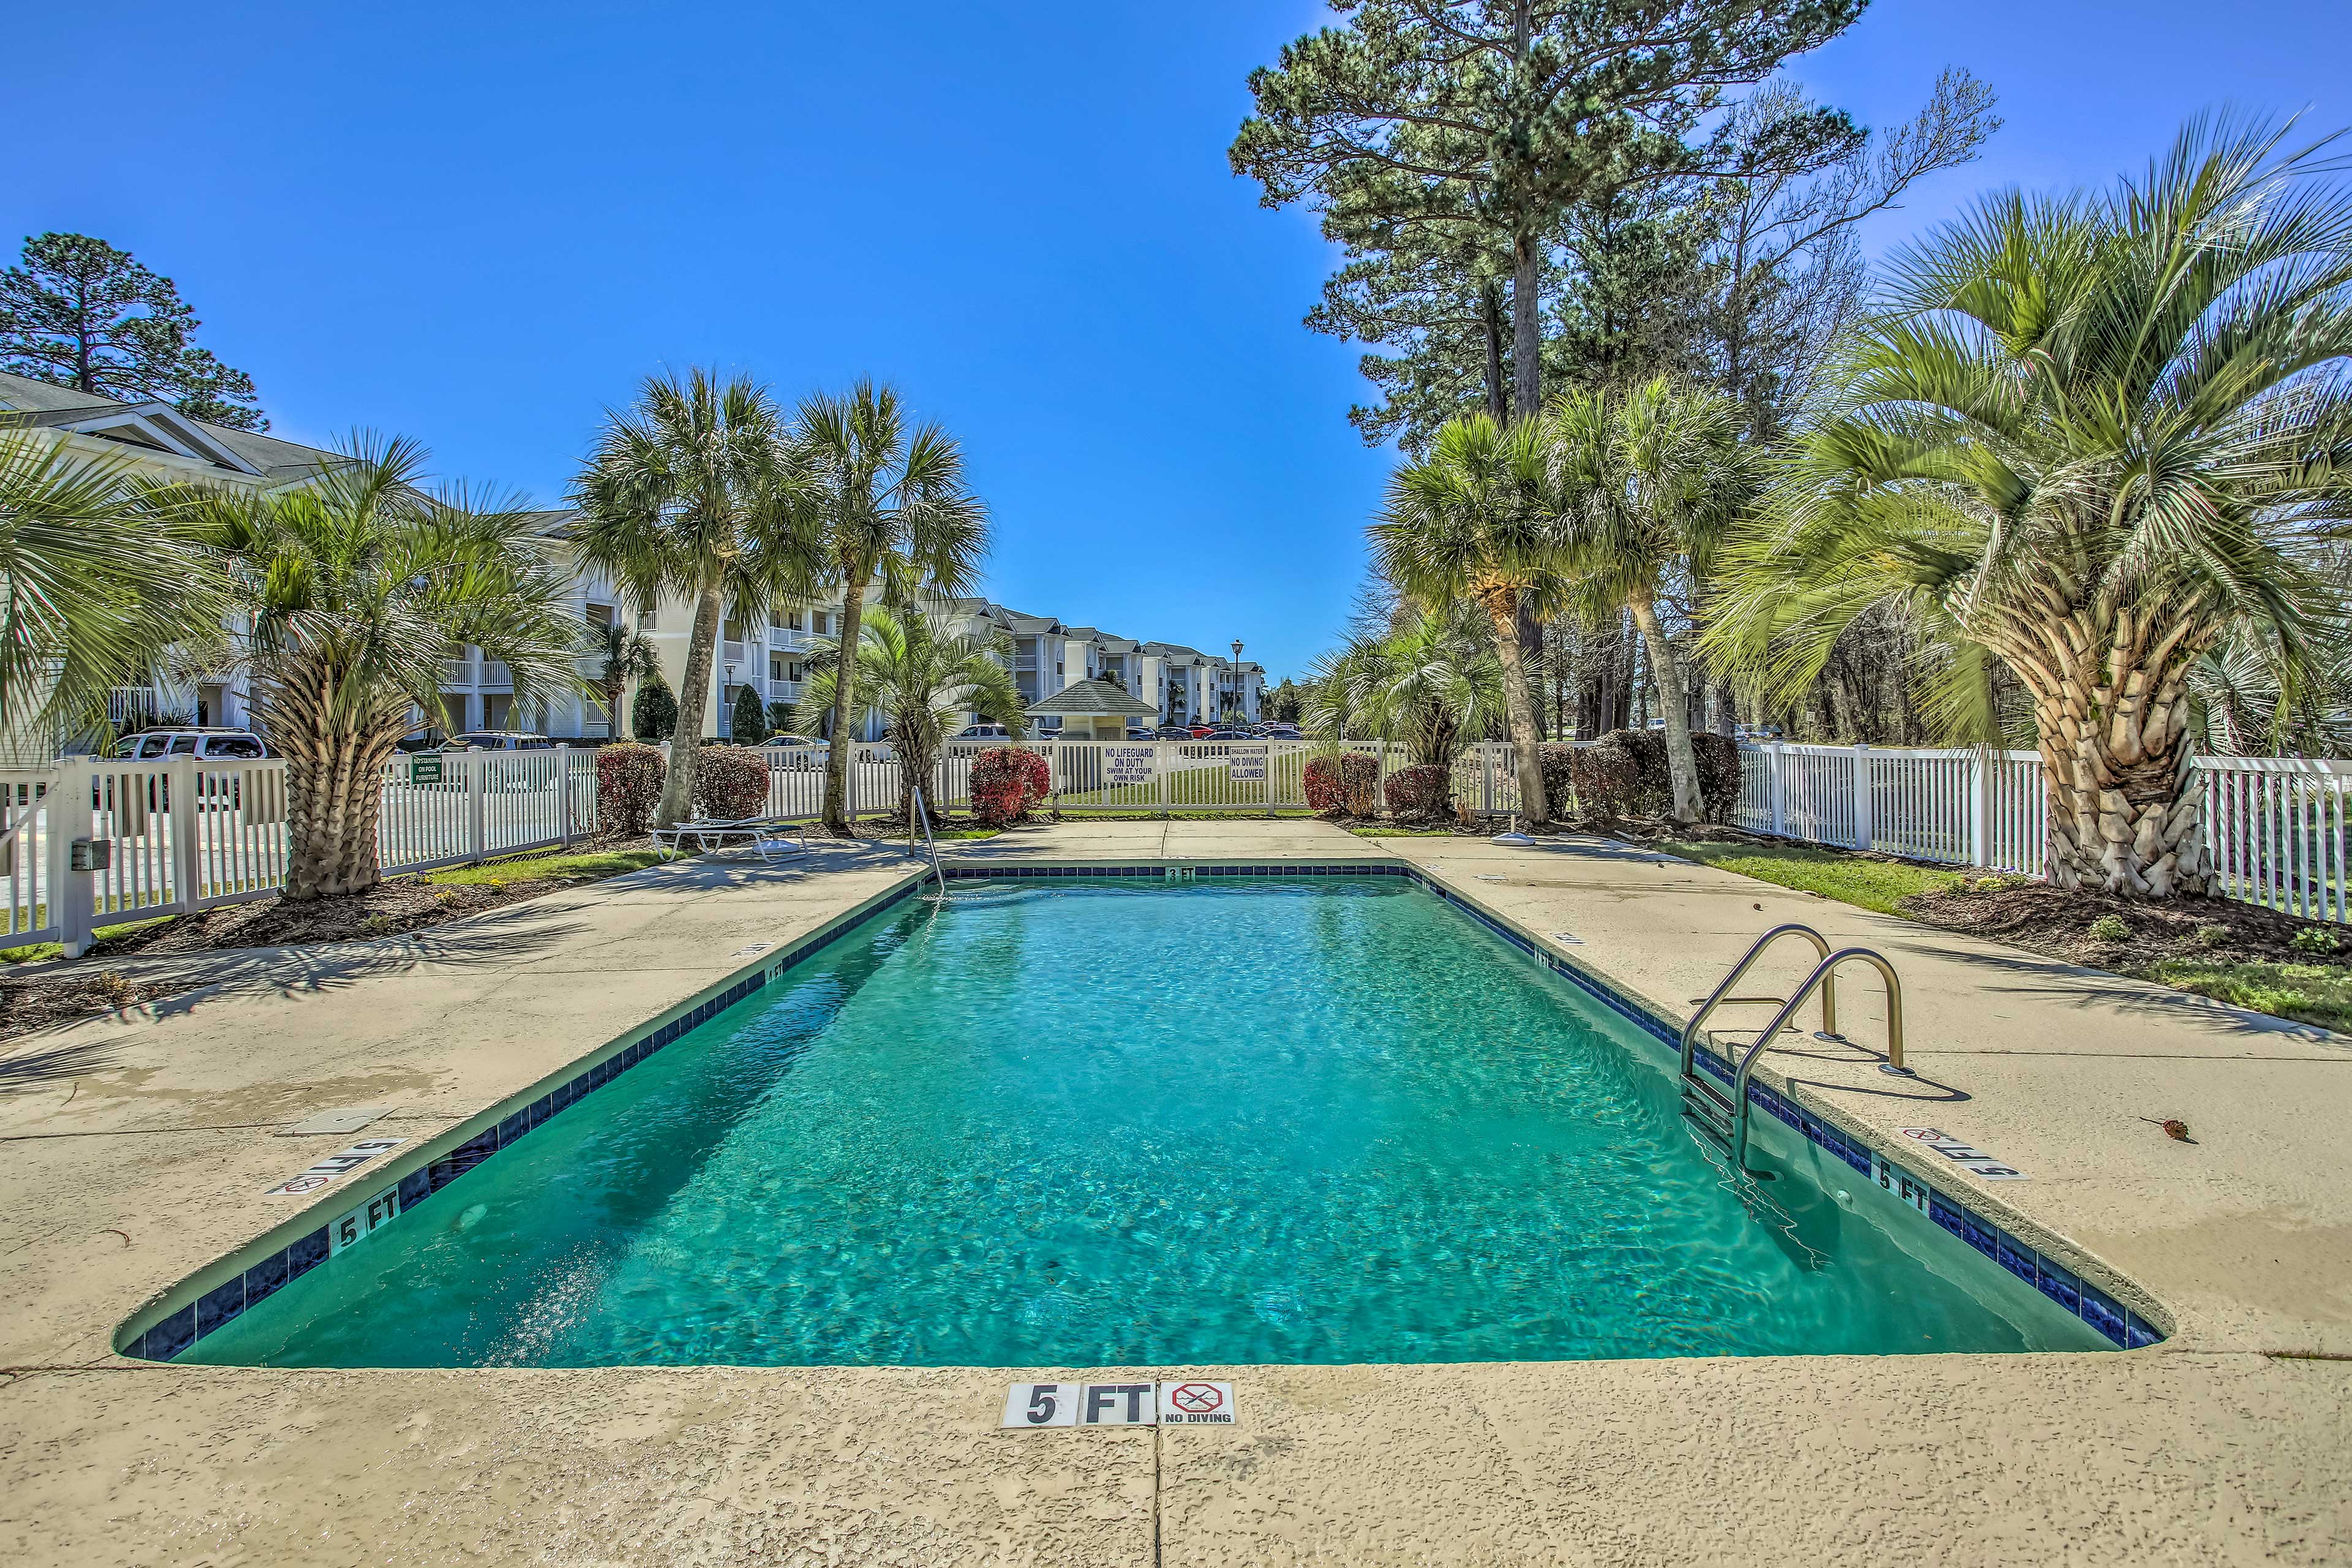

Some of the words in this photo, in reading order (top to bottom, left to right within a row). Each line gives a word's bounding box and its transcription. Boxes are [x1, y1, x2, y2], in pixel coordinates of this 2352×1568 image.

[1106, 748, 1115, 758] NO
[1117, 748, 1153, 758] LIFEGUARD
[1115, 758, 1124, 767] ON
[1126, 758, 1144, 767] DUTY
[1231, 757, 1240, 766] NO
[1242, 757, 1263, 766] DIVING
[1232, 769, 1264, 778] ALLOWED
[1169, 869, 1176, 881] 3
[1927, 1144, 1994, 1159] FT
[309, 1156, 372, 1172] FT
[1968, 1167, 2020, 1176] 5
[1879, 1159, 1891, 1189] 5
[1901, 1176, 1928, 1211] FT
[341, 1216, 357, 1248] 5
[368, 1190, 397, 1231] FT
[1027, 1385, 1058, 1424] 5
[1086, 1384, 1151, 1423] FT
[1165, 1414, 1183, 1423] NO
[1188, 1414, 1231, 1423] DIVING
